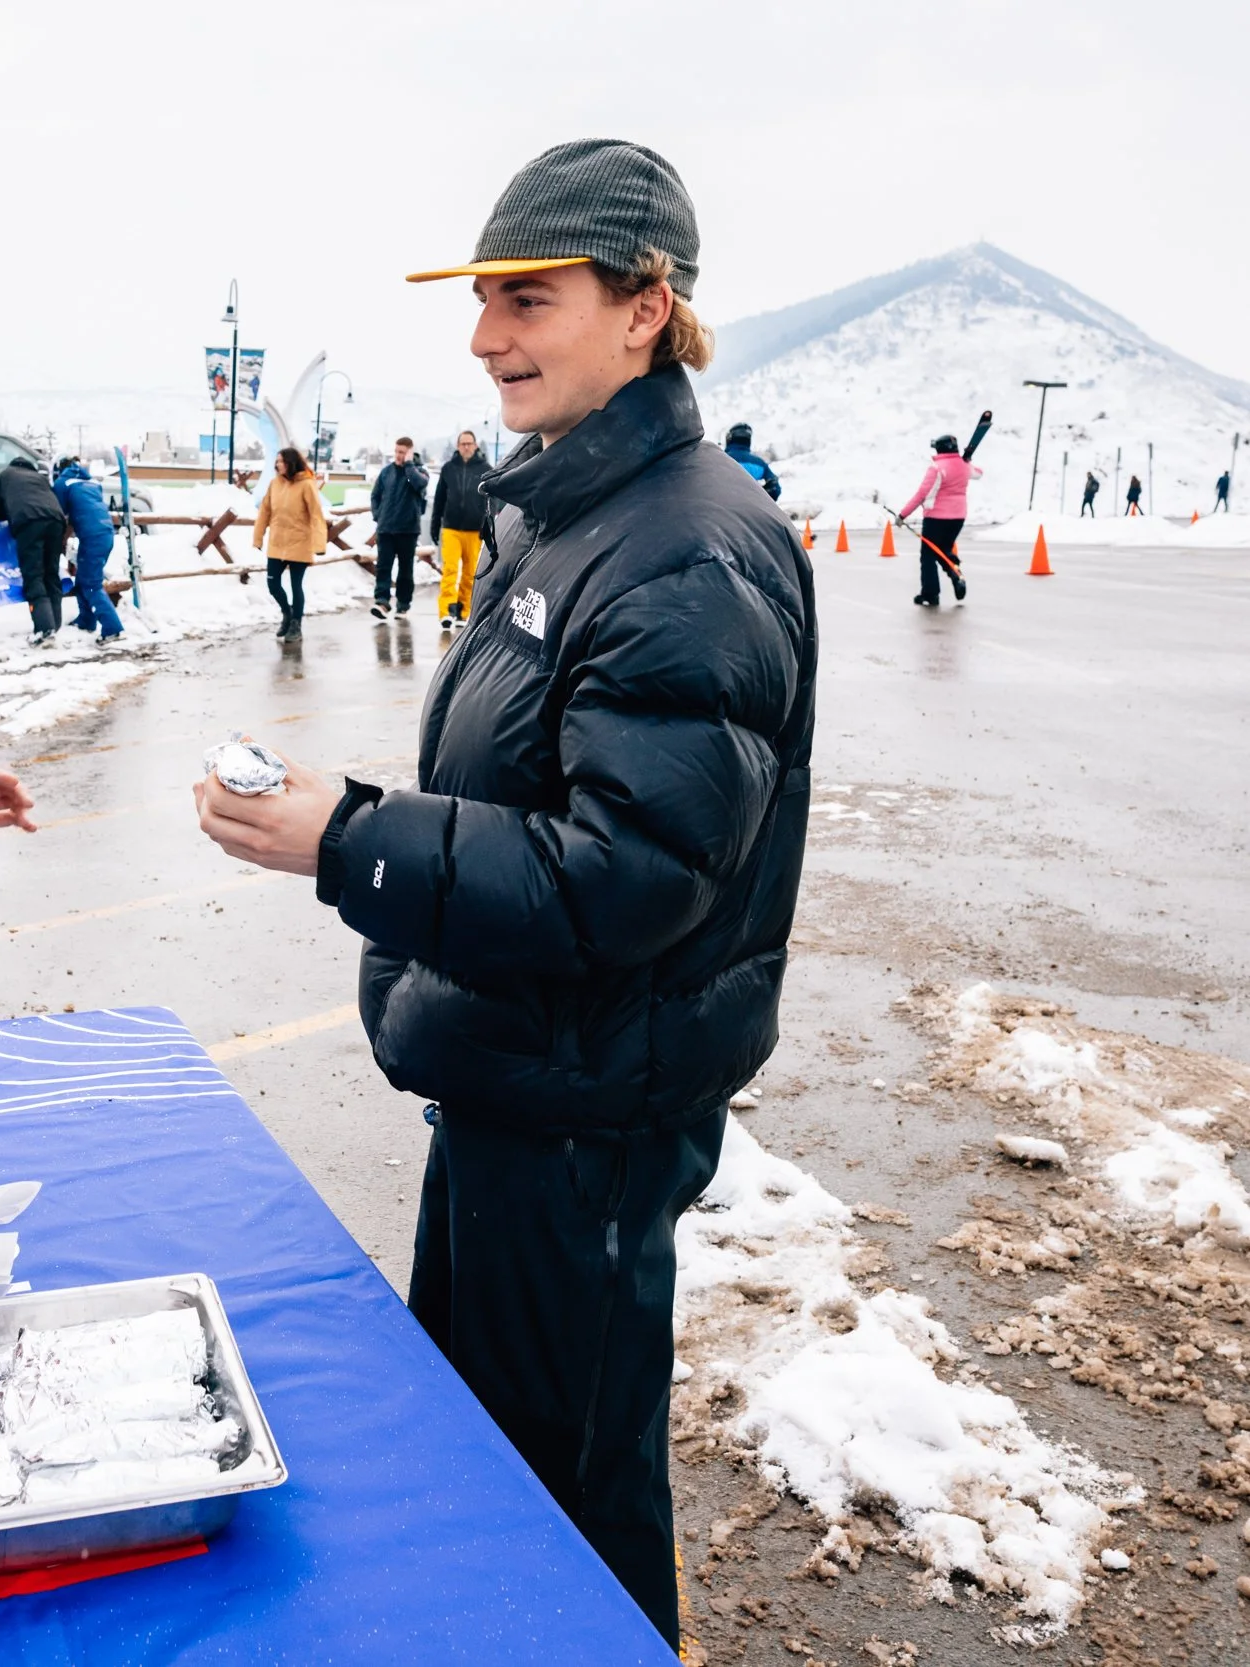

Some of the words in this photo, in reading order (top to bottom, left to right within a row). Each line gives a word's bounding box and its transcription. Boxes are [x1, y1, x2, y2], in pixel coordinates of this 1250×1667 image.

[526, 587, 541, 605] THE
[510, 595, 537, 620] NORTH
[512, 610, 534, 630] FACE
[373, 859, 385, 889] 700
